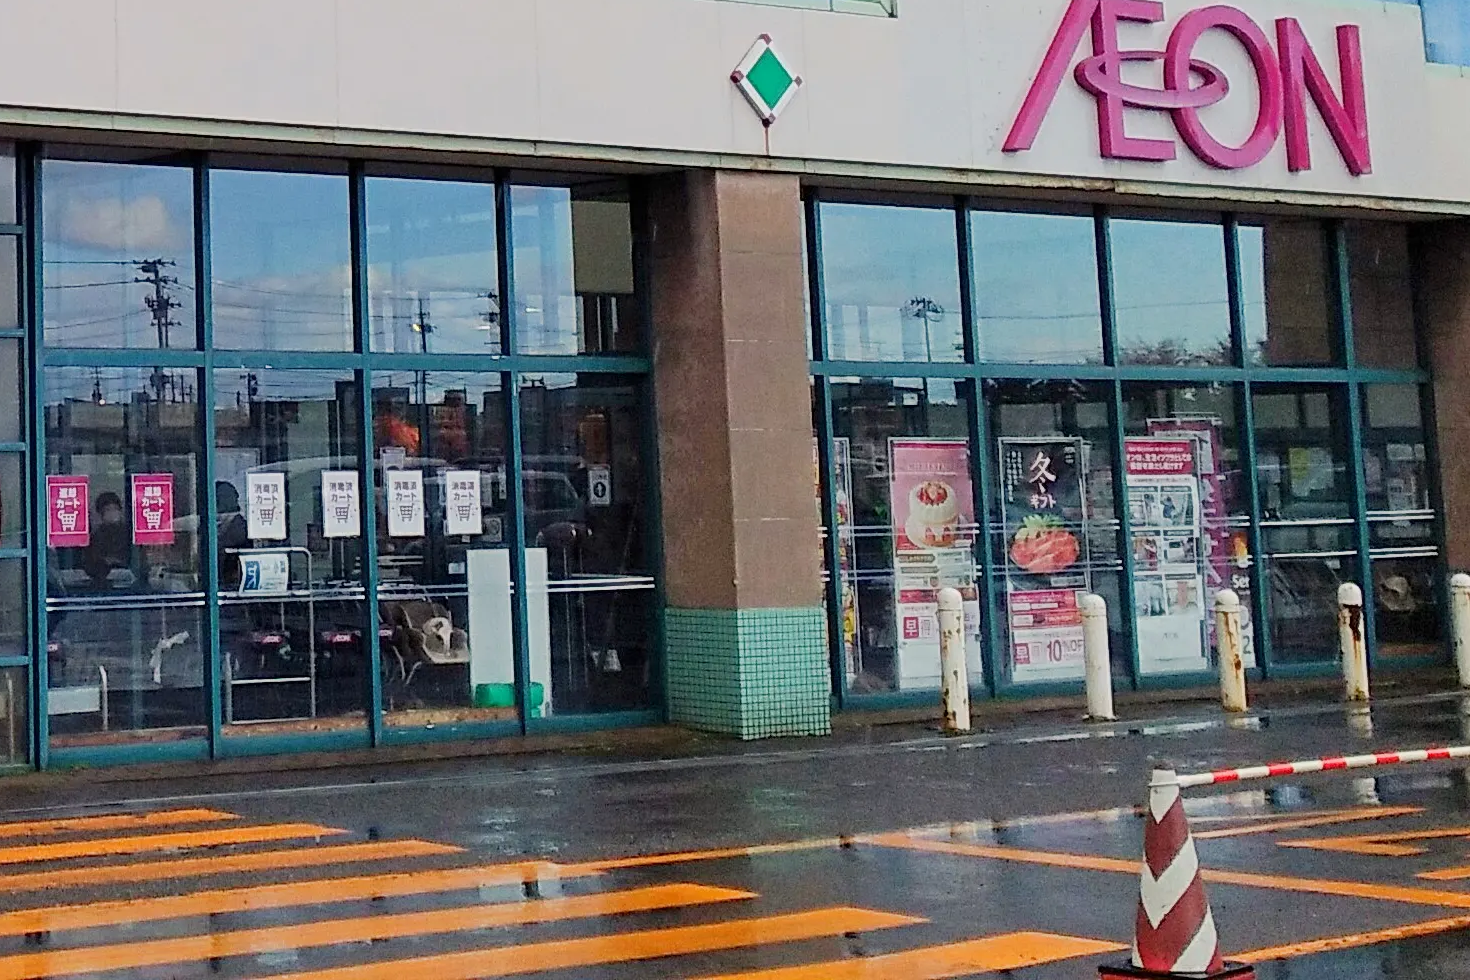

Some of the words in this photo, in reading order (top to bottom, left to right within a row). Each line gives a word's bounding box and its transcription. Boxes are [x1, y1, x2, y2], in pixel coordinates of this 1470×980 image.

[1029, 451, 1057, 494] 冬
[255, 495, 278, 505] カート
[330, 493, 353, 503] カート
[395, 492, 417, 502] カート
[453, 492, 475, 502] カート
[1029, 493, 1058, 510] ギフト
[55, 499, 81, 510] カート
[140, 497, 166, 508] カート
